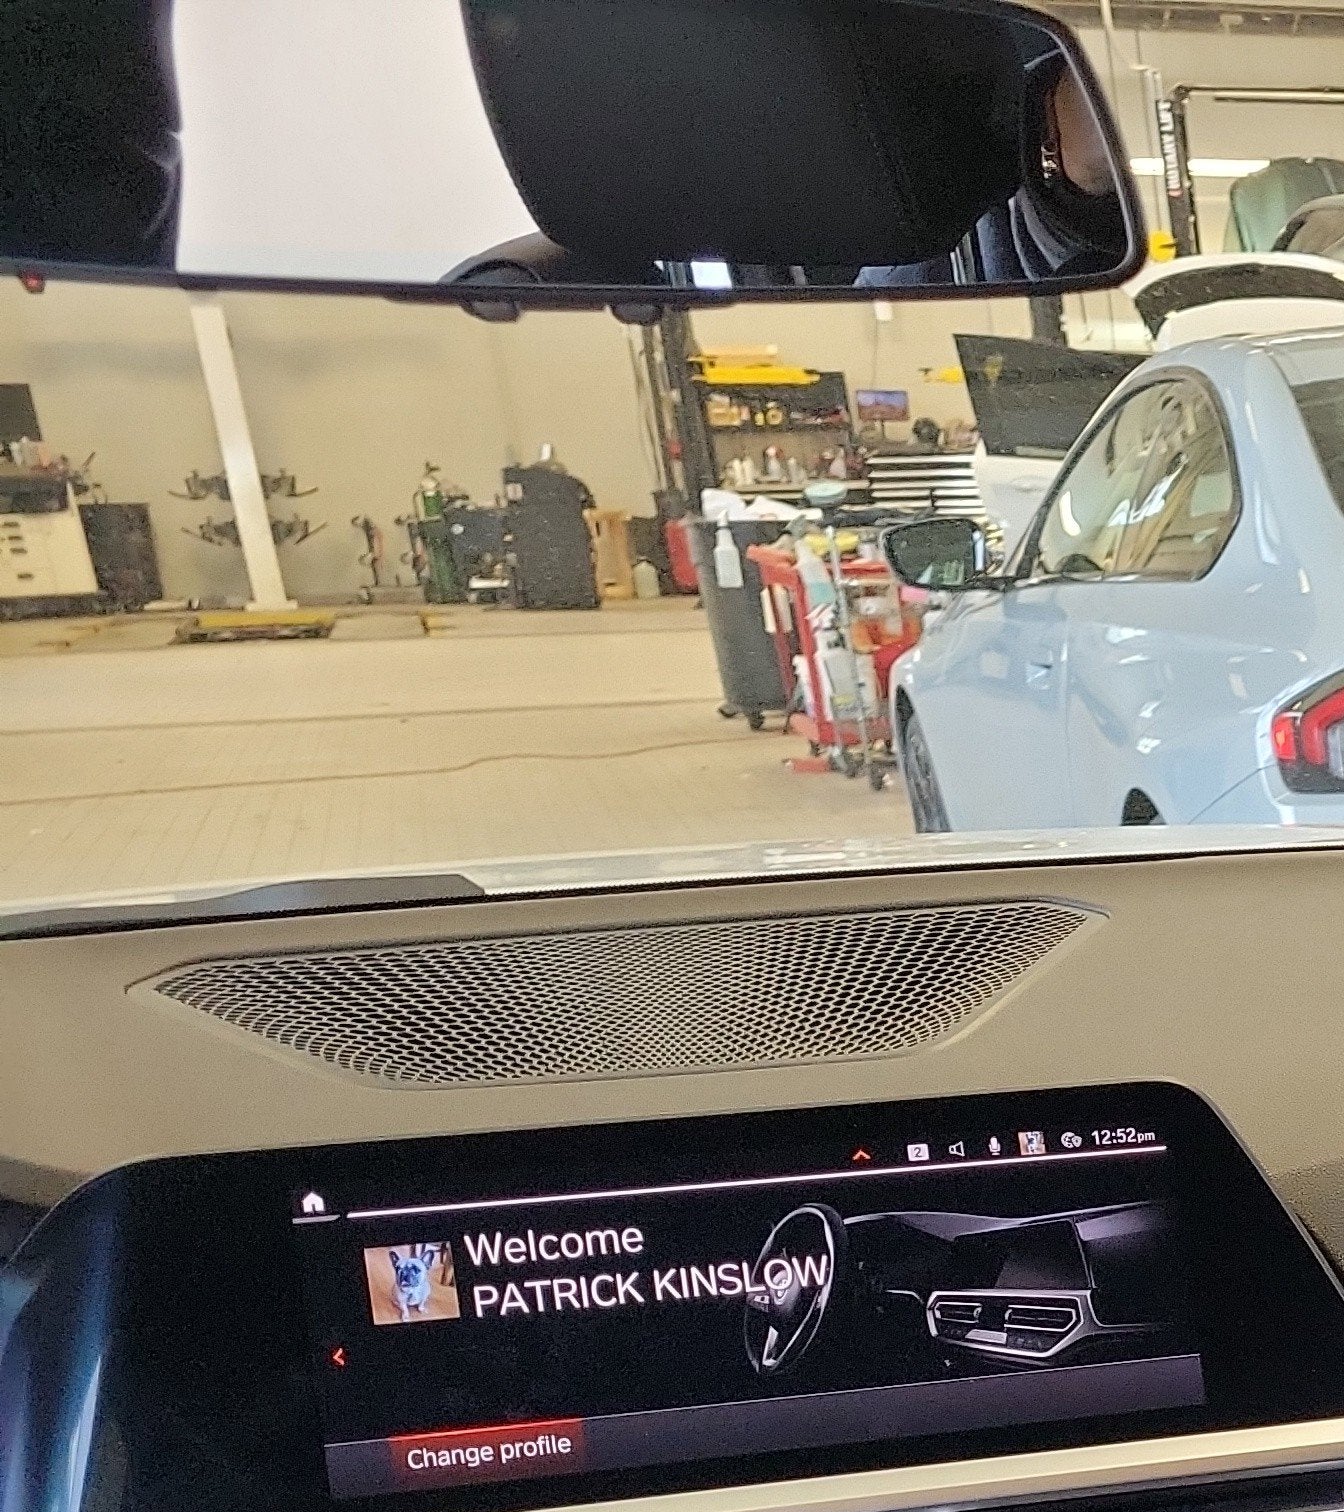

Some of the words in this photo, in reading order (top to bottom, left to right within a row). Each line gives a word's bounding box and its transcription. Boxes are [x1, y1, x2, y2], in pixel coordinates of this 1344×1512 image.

[1091, 1127, 1156, 1145] 12:52pm
[463, 1225, 644, 1267] Welcome
[472, 1270, 645, 1319] PATRICK
[653, 1254, 829, 1301] KINSLOW
[407, 1444, 495, 1470] Change
[500, 1434, 573, 1464] profile
